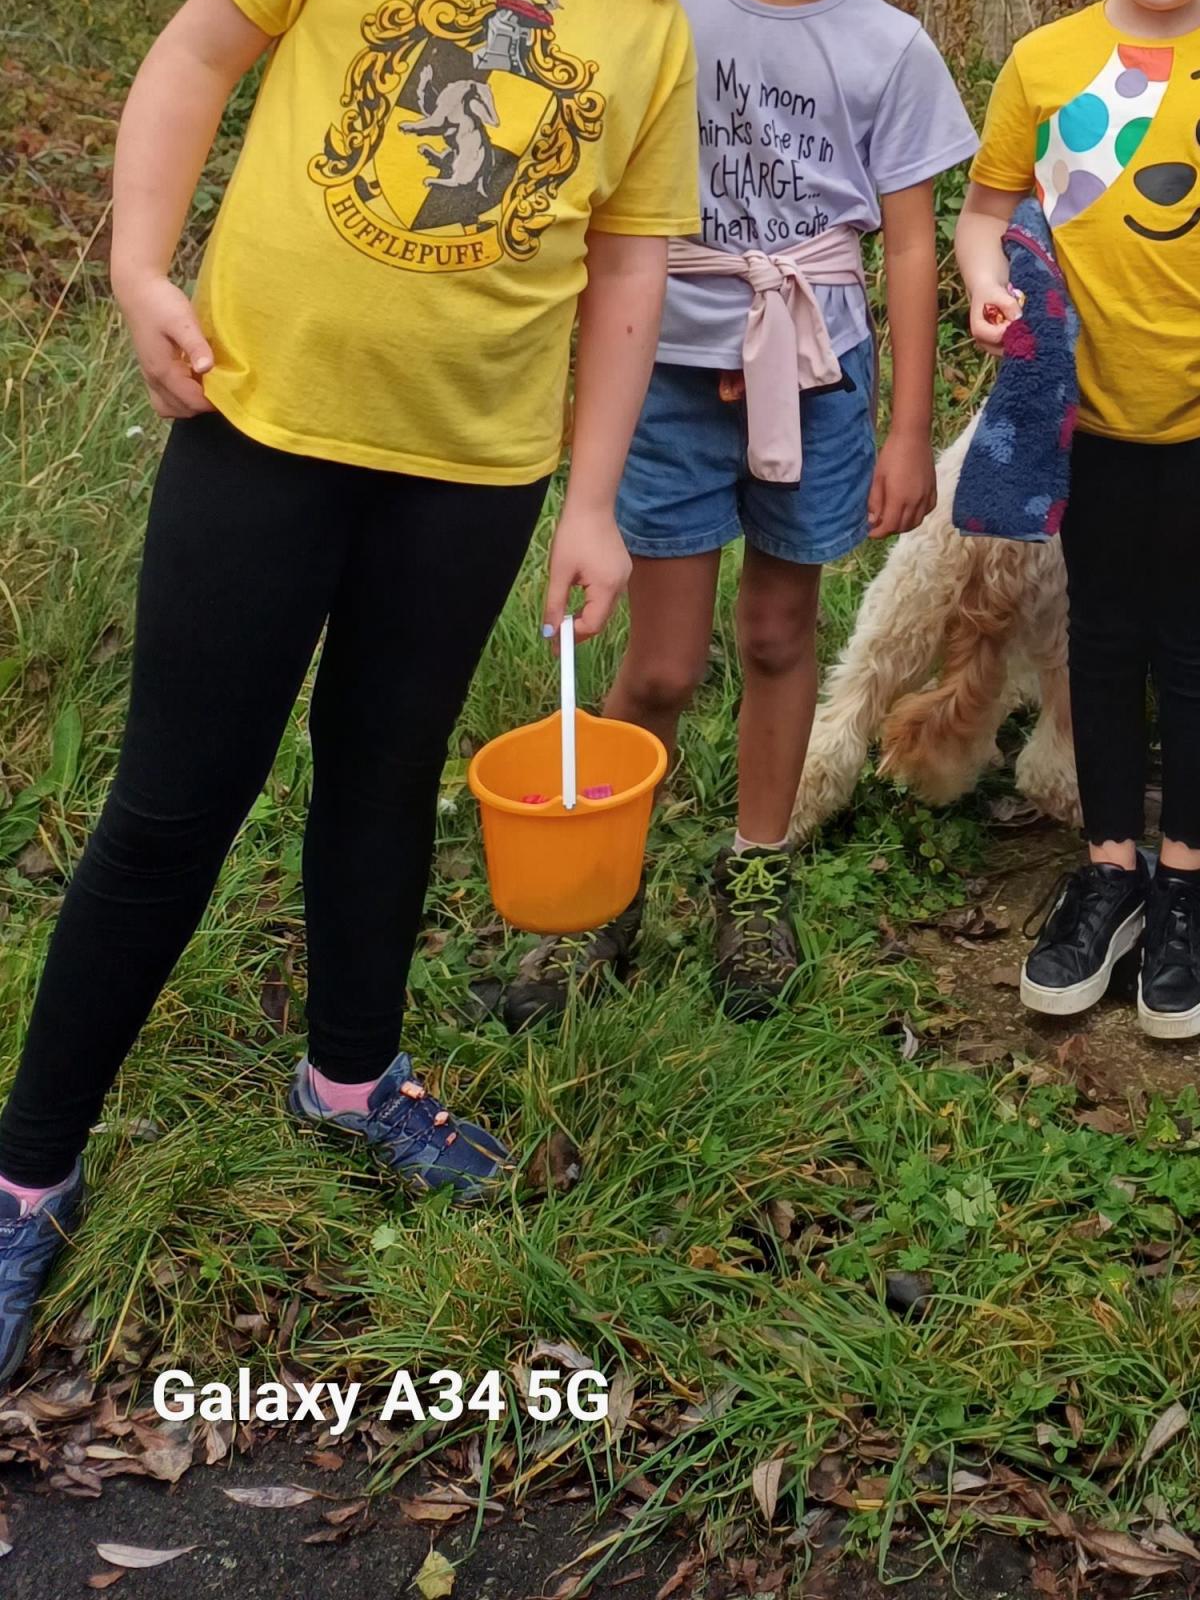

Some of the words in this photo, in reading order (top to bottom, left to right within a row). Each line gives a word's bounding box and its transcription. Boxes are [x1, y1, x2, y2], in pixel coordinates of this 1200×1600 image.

[716, 57, 750, 116] My
[759, 82, 816, 119] mom
[698, 111, 752, 148] hinks
[760, 119, 791, 153] she
[798, 133, 815, 160] is
[818, 137, 834, 162] in
[332, 194, 486, 266] HUFFLEPUFF
[764, 218, 790, 243] so
[795, 205, 830, 238] cute
